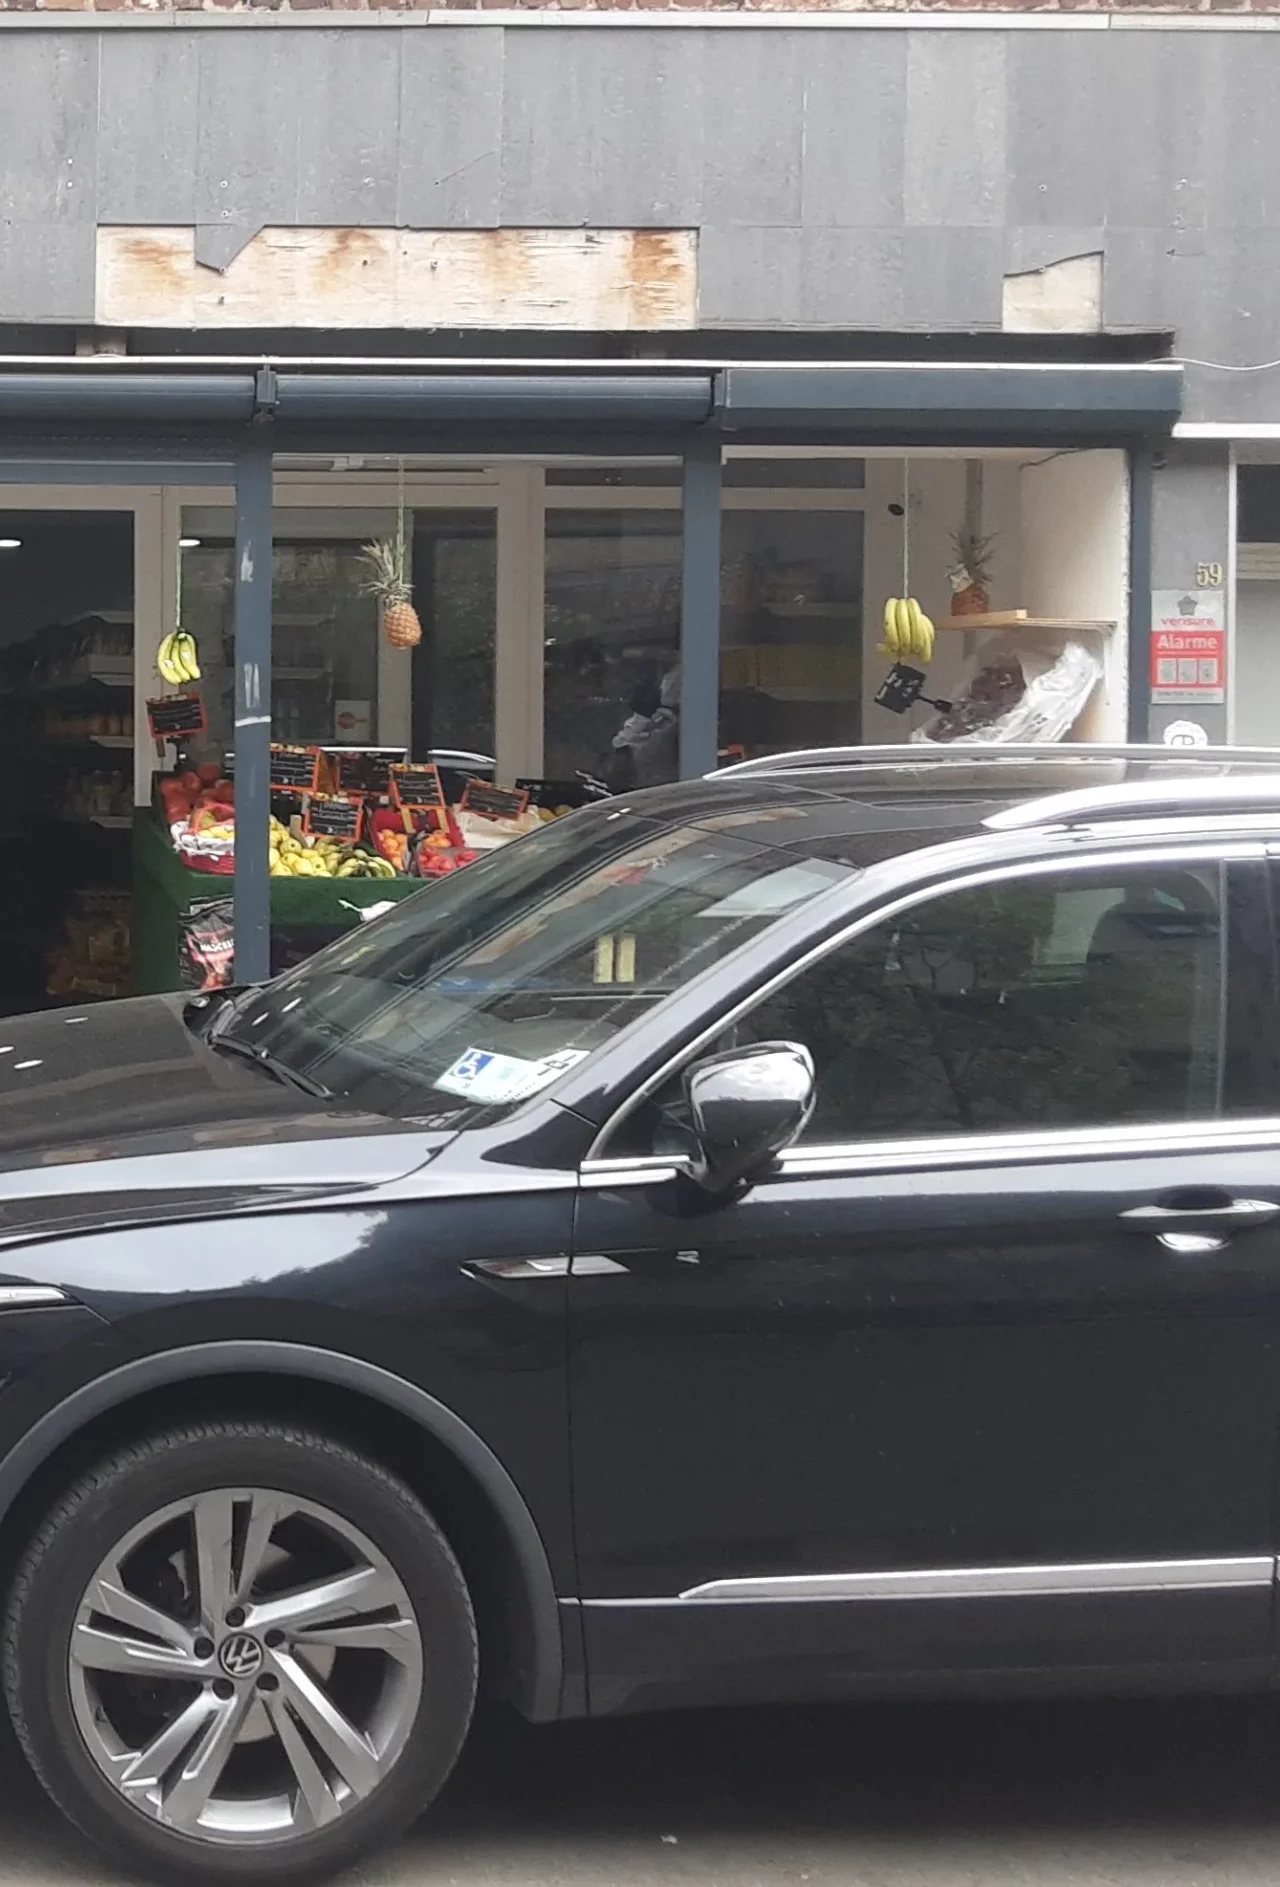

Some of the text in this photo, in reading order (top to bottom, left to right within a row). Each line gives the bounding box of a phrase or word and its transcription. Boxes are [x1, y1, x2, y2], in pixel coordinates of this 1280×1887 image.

[1196, 562, 1223, 586] 59
[1160, 617, 1216, 626] verisure
[1156, 634, 1219, 649] Alarme
